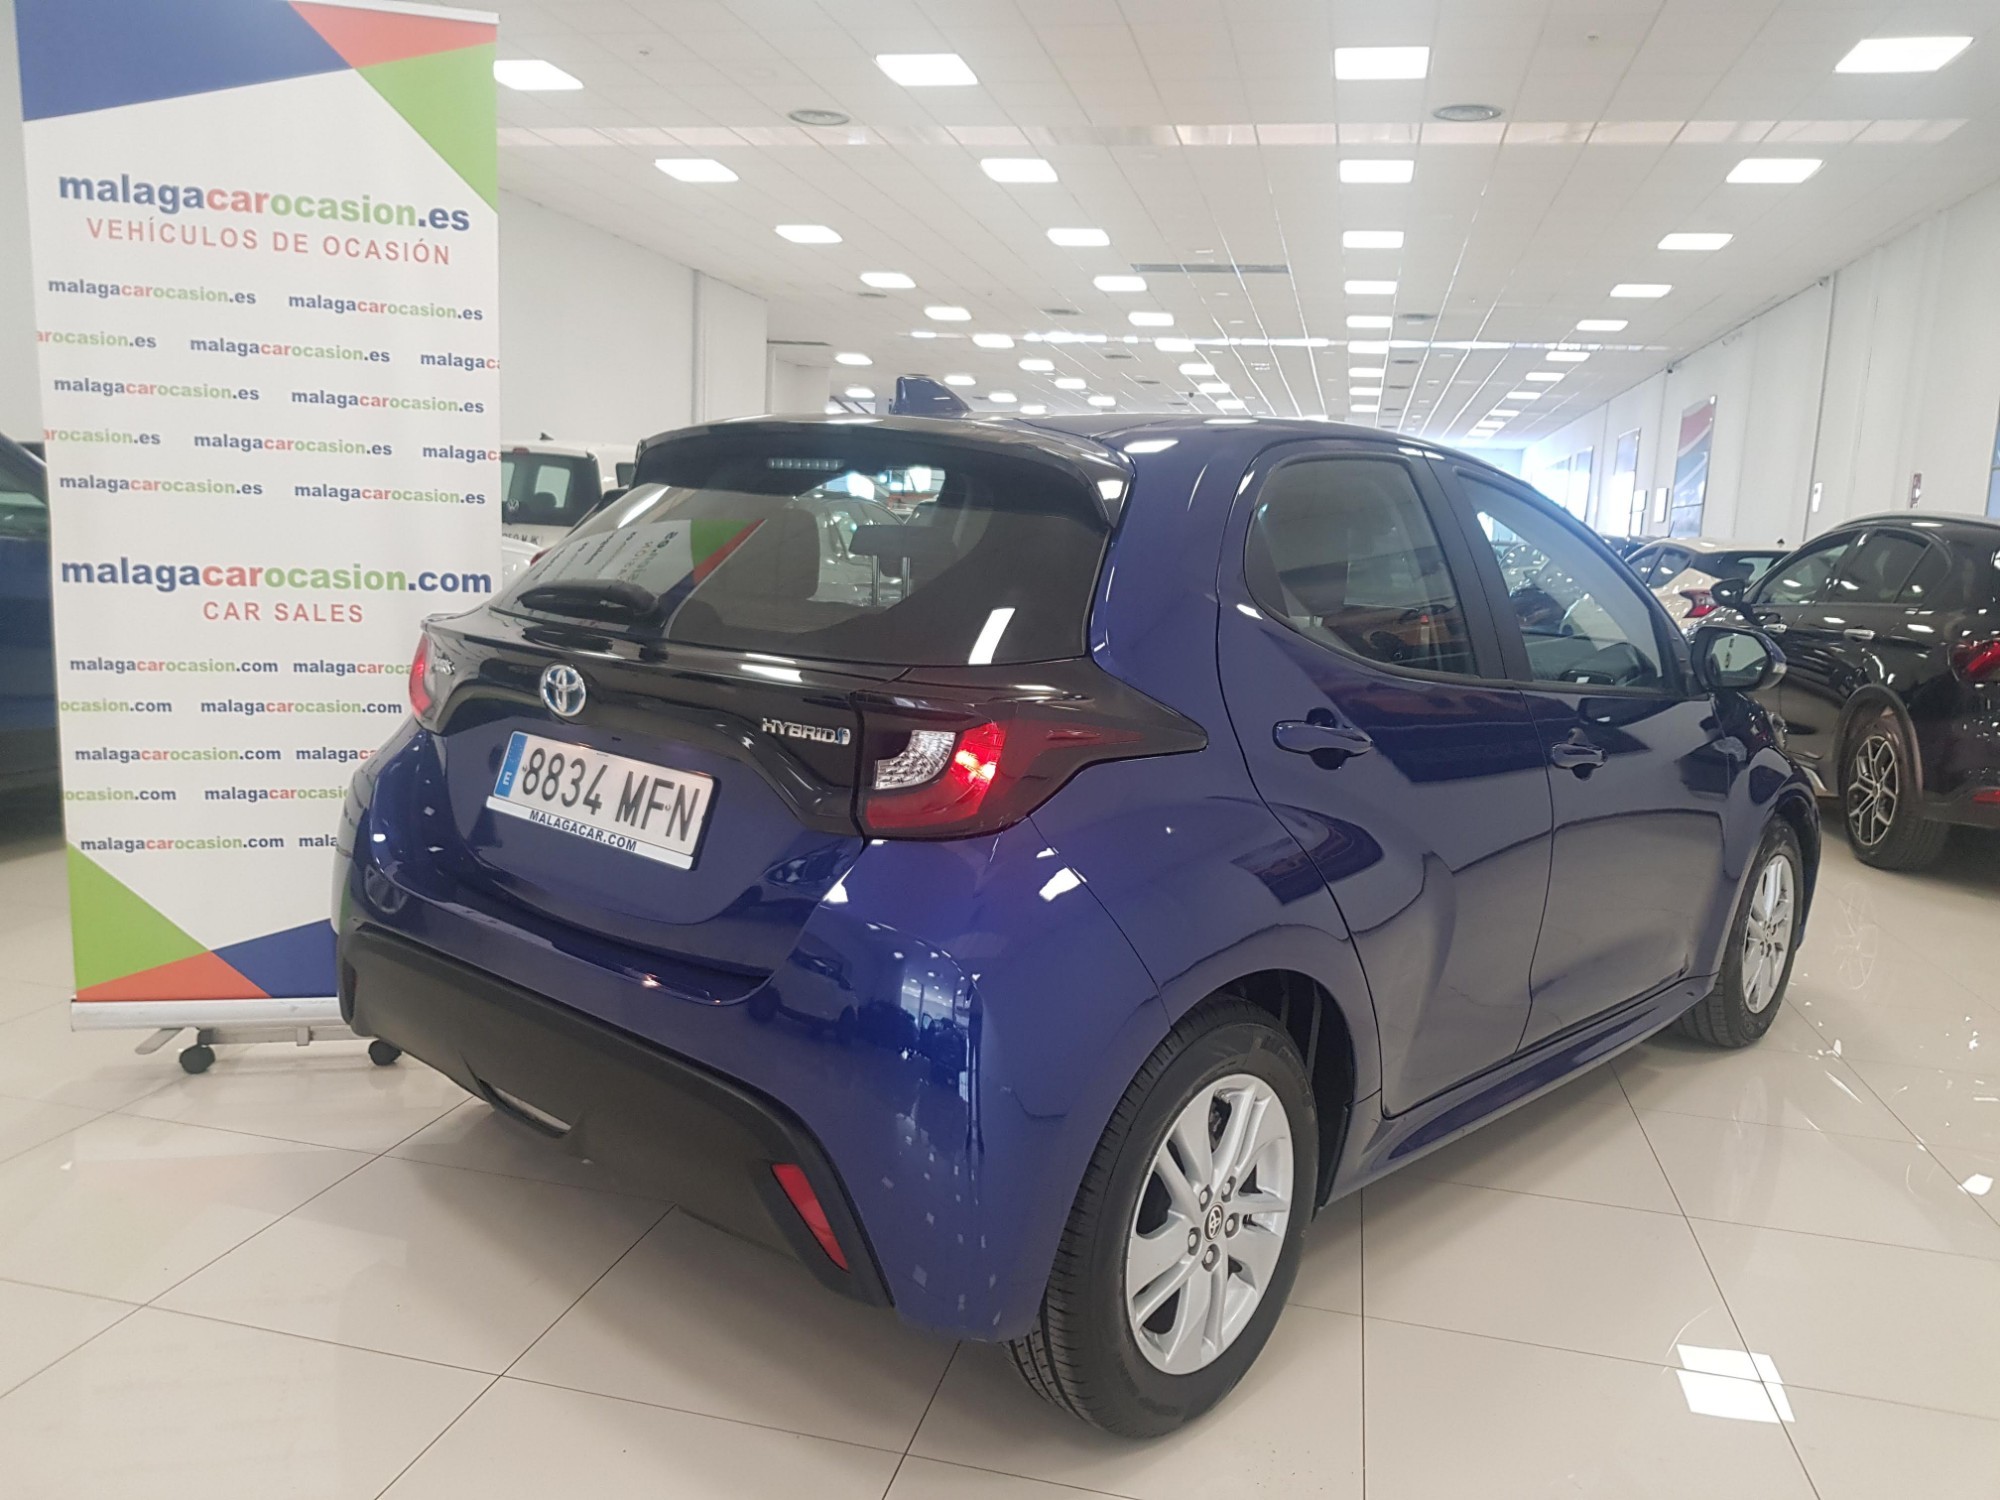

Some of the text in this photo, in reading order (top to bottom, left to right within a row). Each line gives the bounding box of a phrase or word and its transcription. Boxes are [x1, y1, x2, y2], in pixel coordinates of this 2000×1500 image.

[58, 174, 472, 232] malagacarocasion.es
[86, 216, 451, 266] VEHÍCULOS DE OCASIÓN
[48, 279, 257, 305] malagacarocasion.es
[288, 293, 484, 321] malagacarocasion.es
[190, 338, 391, 363] malagacarocasion.es
[420, 353, 500, 371] malagac
[54, 377, 260, 401] malagacarocasion.es
[291, 390, 485, 414] malagacarocasion.es
[194, 434, 393, 456] malagacarocasion.es
[423, 445, 501, 463] malagac
[59, 474, 263, 496] malagacarocasion.es
[294, 483, 486, 505] malagacarocasion.es
[61, 557, 493, 593] malagacarocasion.com
[203, 602, 363, 624] CAR SALES
[70, 657, 279, 675] malagacarocasion.com
[60, 699, 172, 712] ocasion.com
[201, 699, 402, 716] malagacarocasion.com
[762, 717, 836, 743] HYBRID
[75, 747, 282, 764] malagacarocasion.com
[502, 771, 512, 785] E
[65, 787, 176, 801] ocasion.com
[521, 747, 700, 842] 8834 MFN
[529, 809, 637, 852] MALAGACAR.COM
[81, 836, 284, 853] malagacarocasion.com
